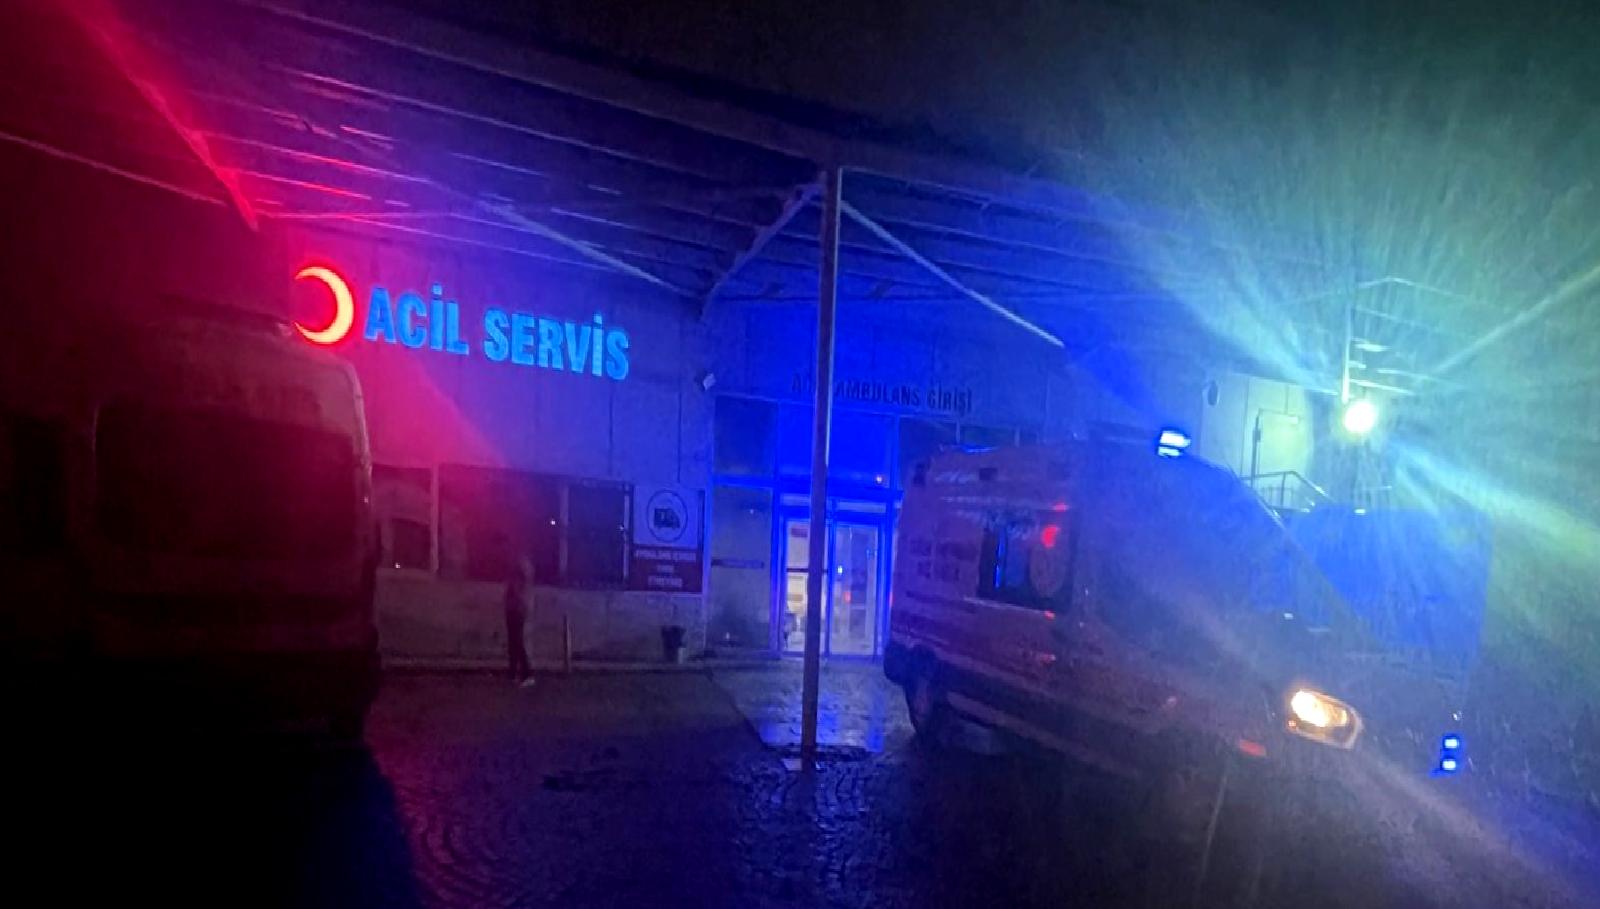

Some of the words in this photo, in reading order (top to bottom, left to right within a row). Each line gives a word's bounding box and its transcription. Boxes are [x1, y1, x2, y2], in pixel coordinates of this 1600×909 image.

[364, 282, 470, 355] ACİL
[483, 307, 630, 380] SERVİS
[834, 380, 921, 407] AMBULANS
